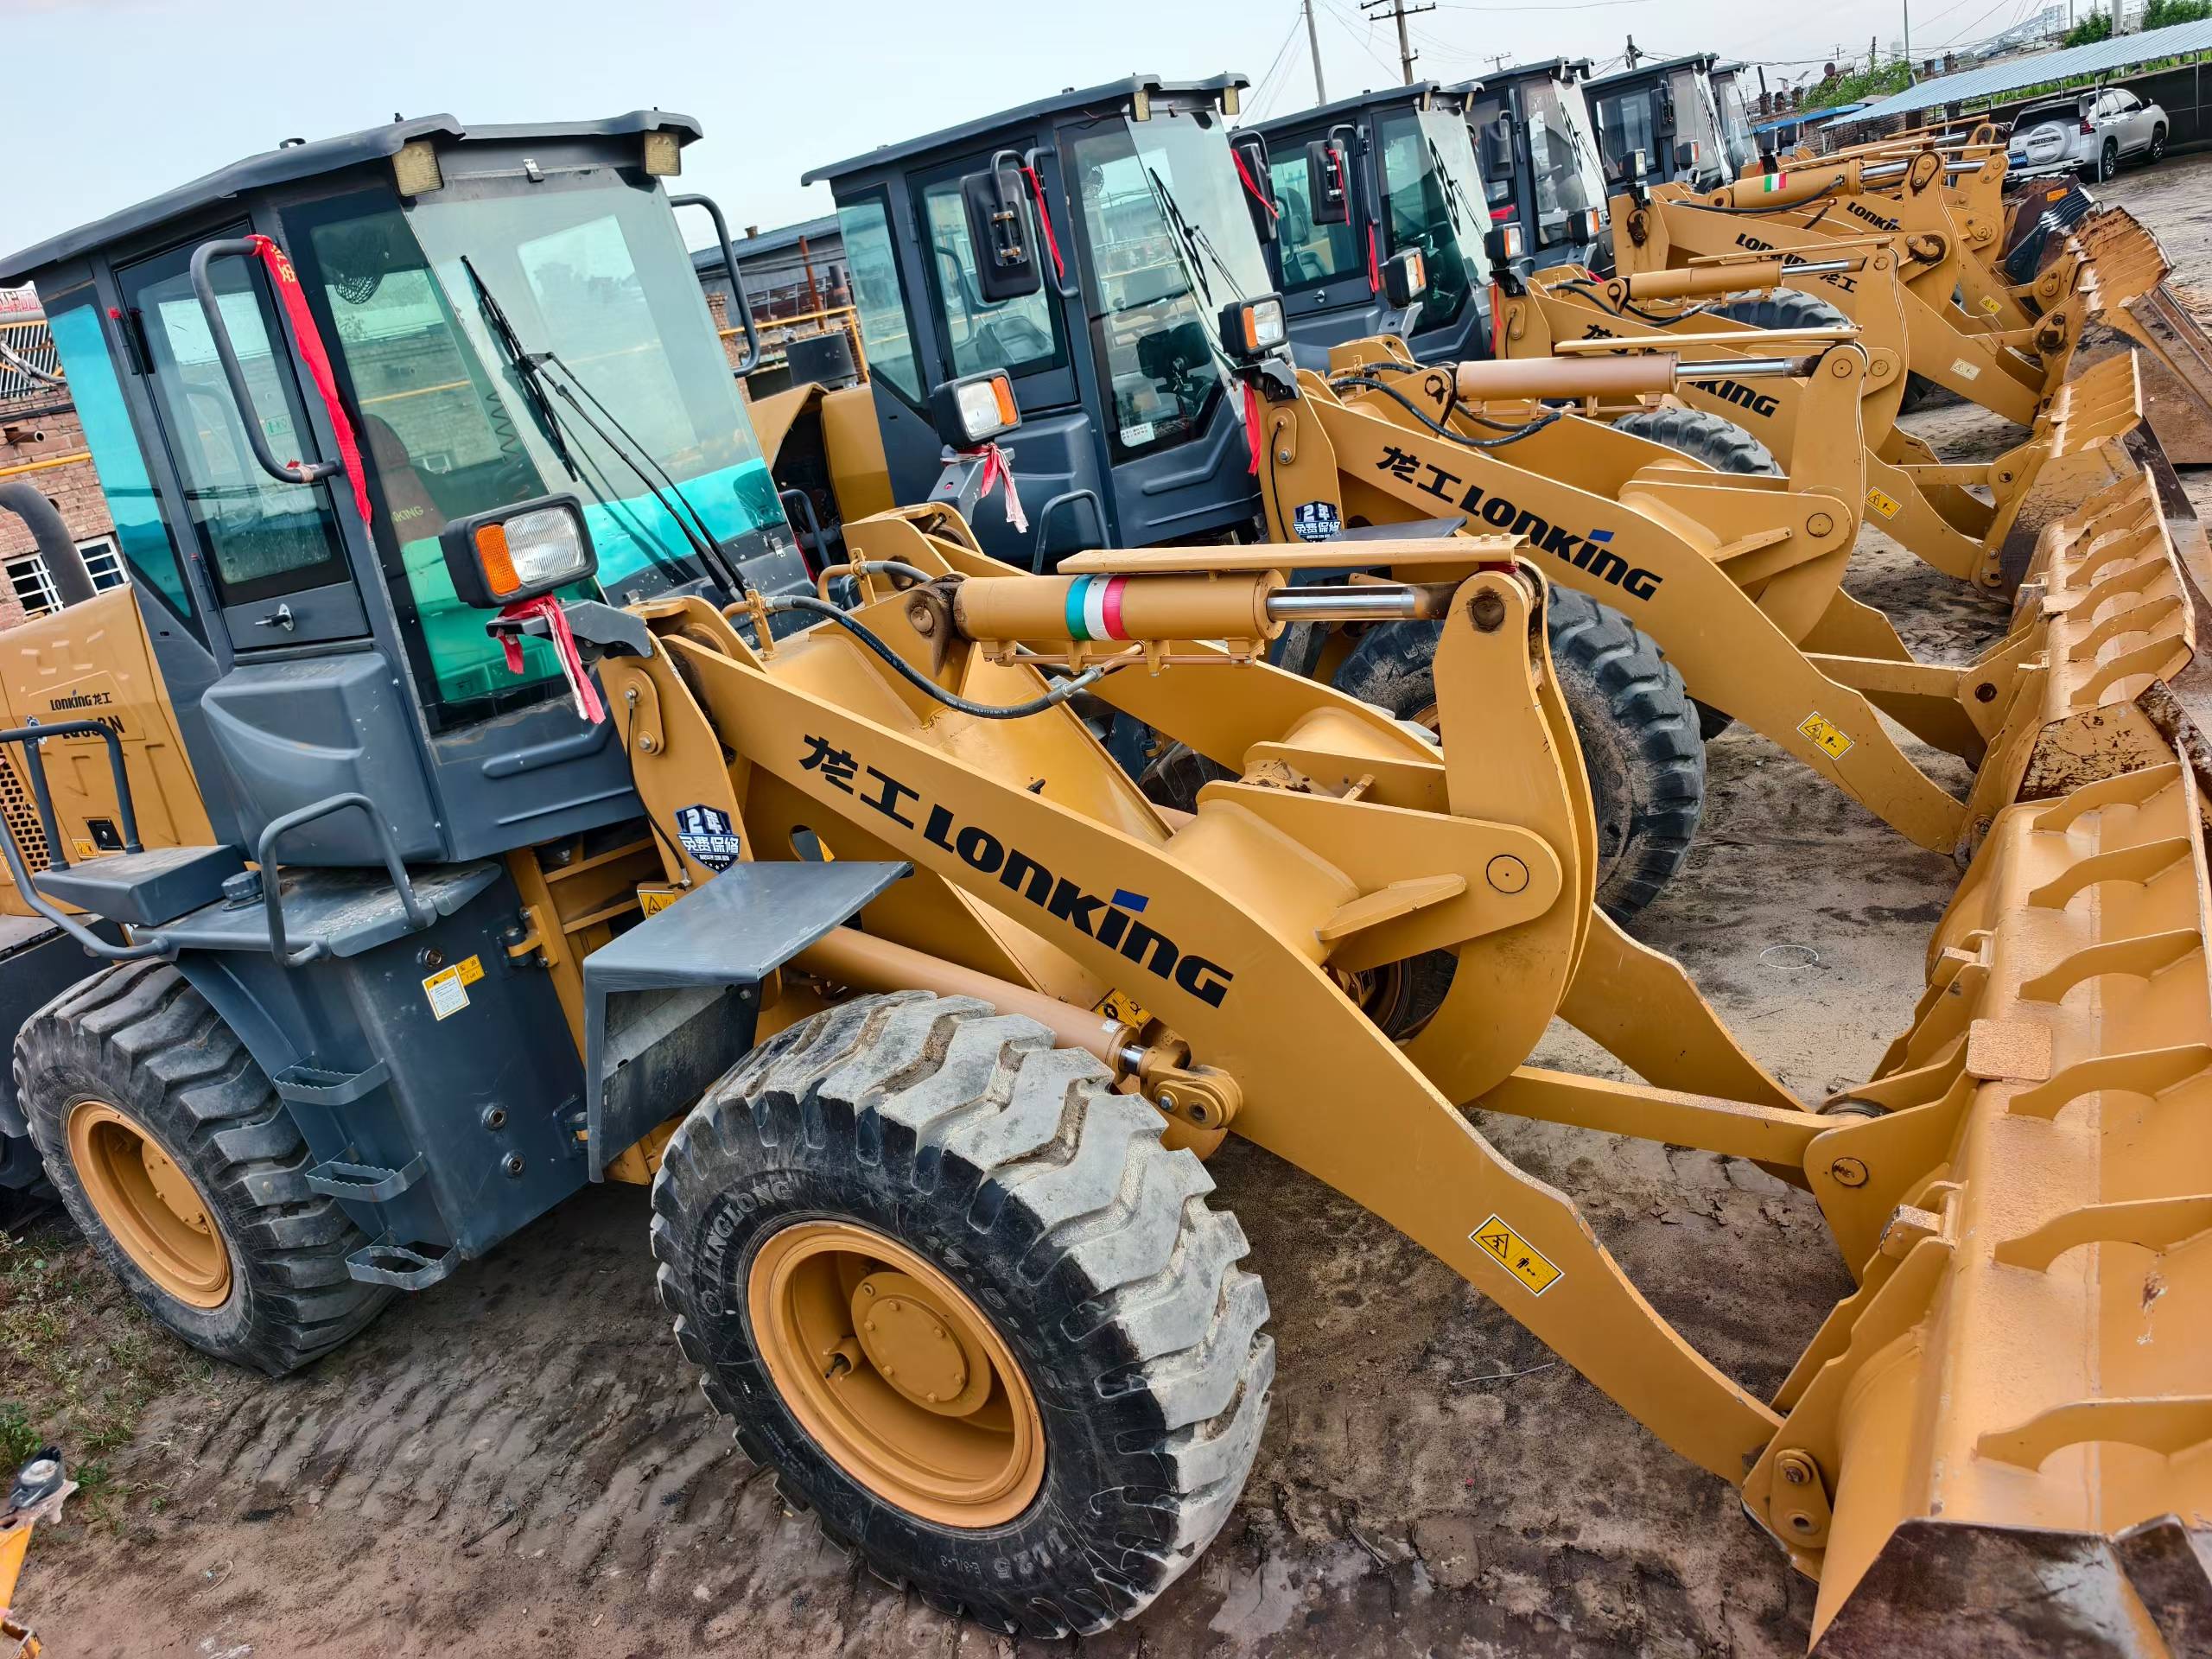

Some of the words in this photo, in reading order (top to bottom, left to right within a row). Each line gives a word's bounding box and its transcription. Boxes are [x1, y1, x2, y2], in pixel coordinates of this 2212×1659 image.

[1376, 446, 1462, 504] 龙工
[1303, 503, 1331, 522] 2年
[798, 734, 920, 830] 龙工
[686, 808, 723, 834] 2年
[677, 836, 739, 854] 免费保修
[703, 1181, 794, 1287] LINGLONG
